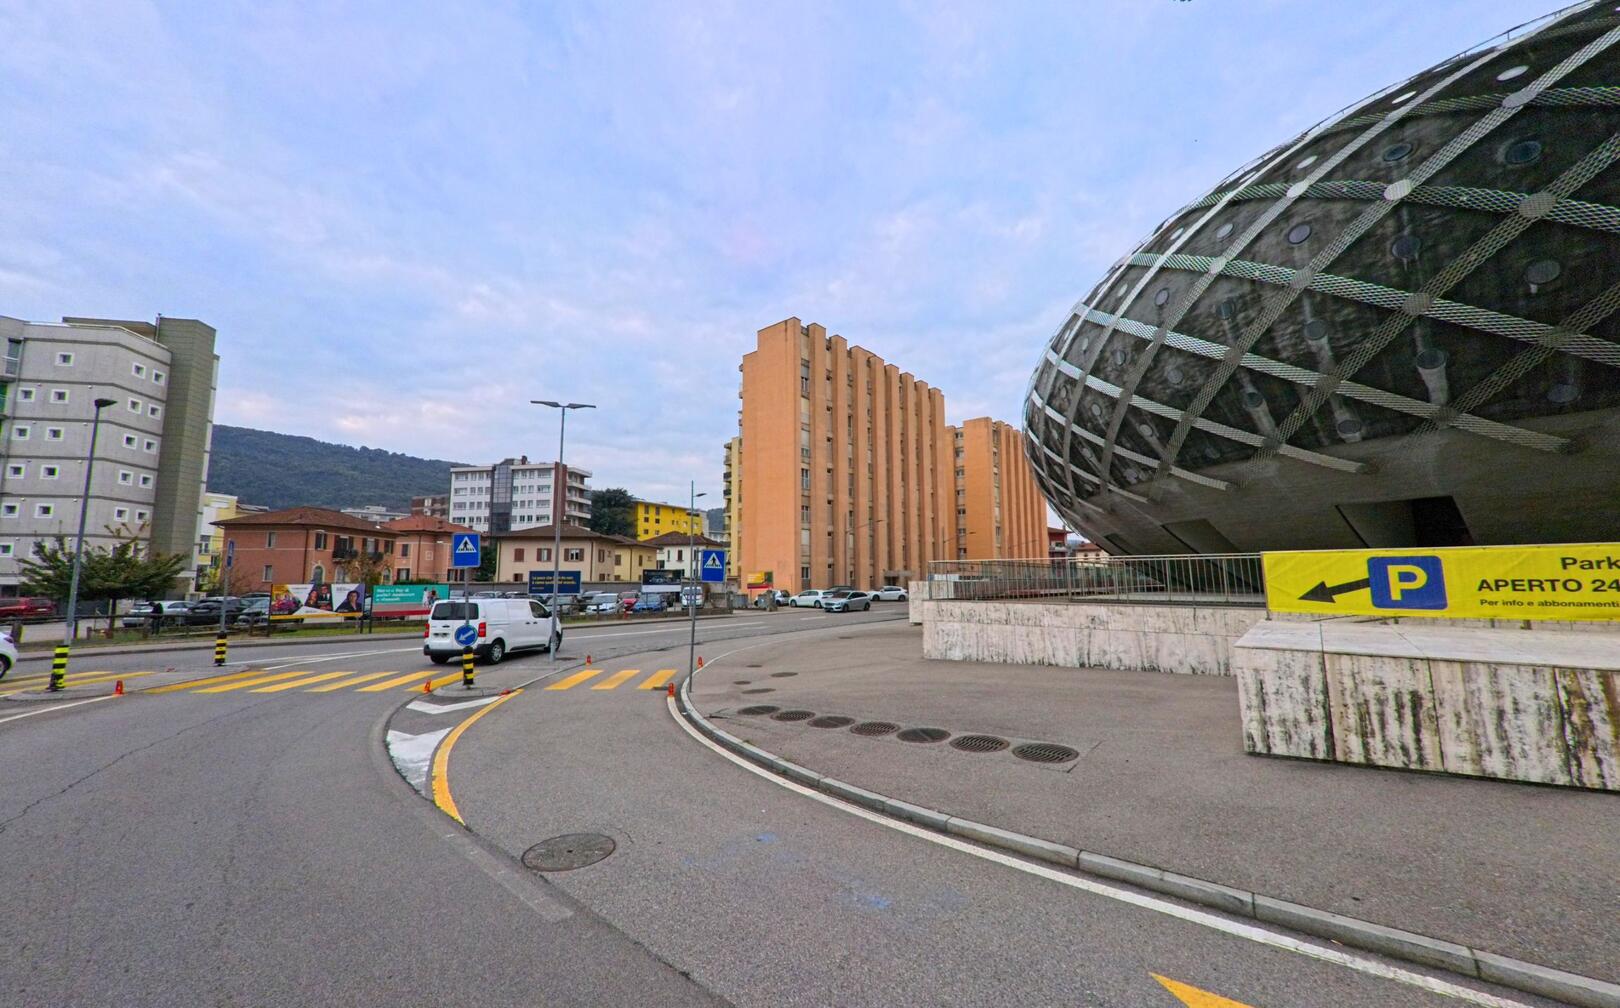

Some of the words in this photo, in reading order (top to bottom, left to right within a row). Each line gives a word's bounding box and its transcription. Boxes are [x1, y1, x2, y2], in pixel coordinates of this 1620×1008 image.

[1560, 556, 1620, 570] Park
[1387, 564, 1427, 600] P
[1477, 579, 1582, 592] APERTO
[1592, 579, 1620, 592] 24
